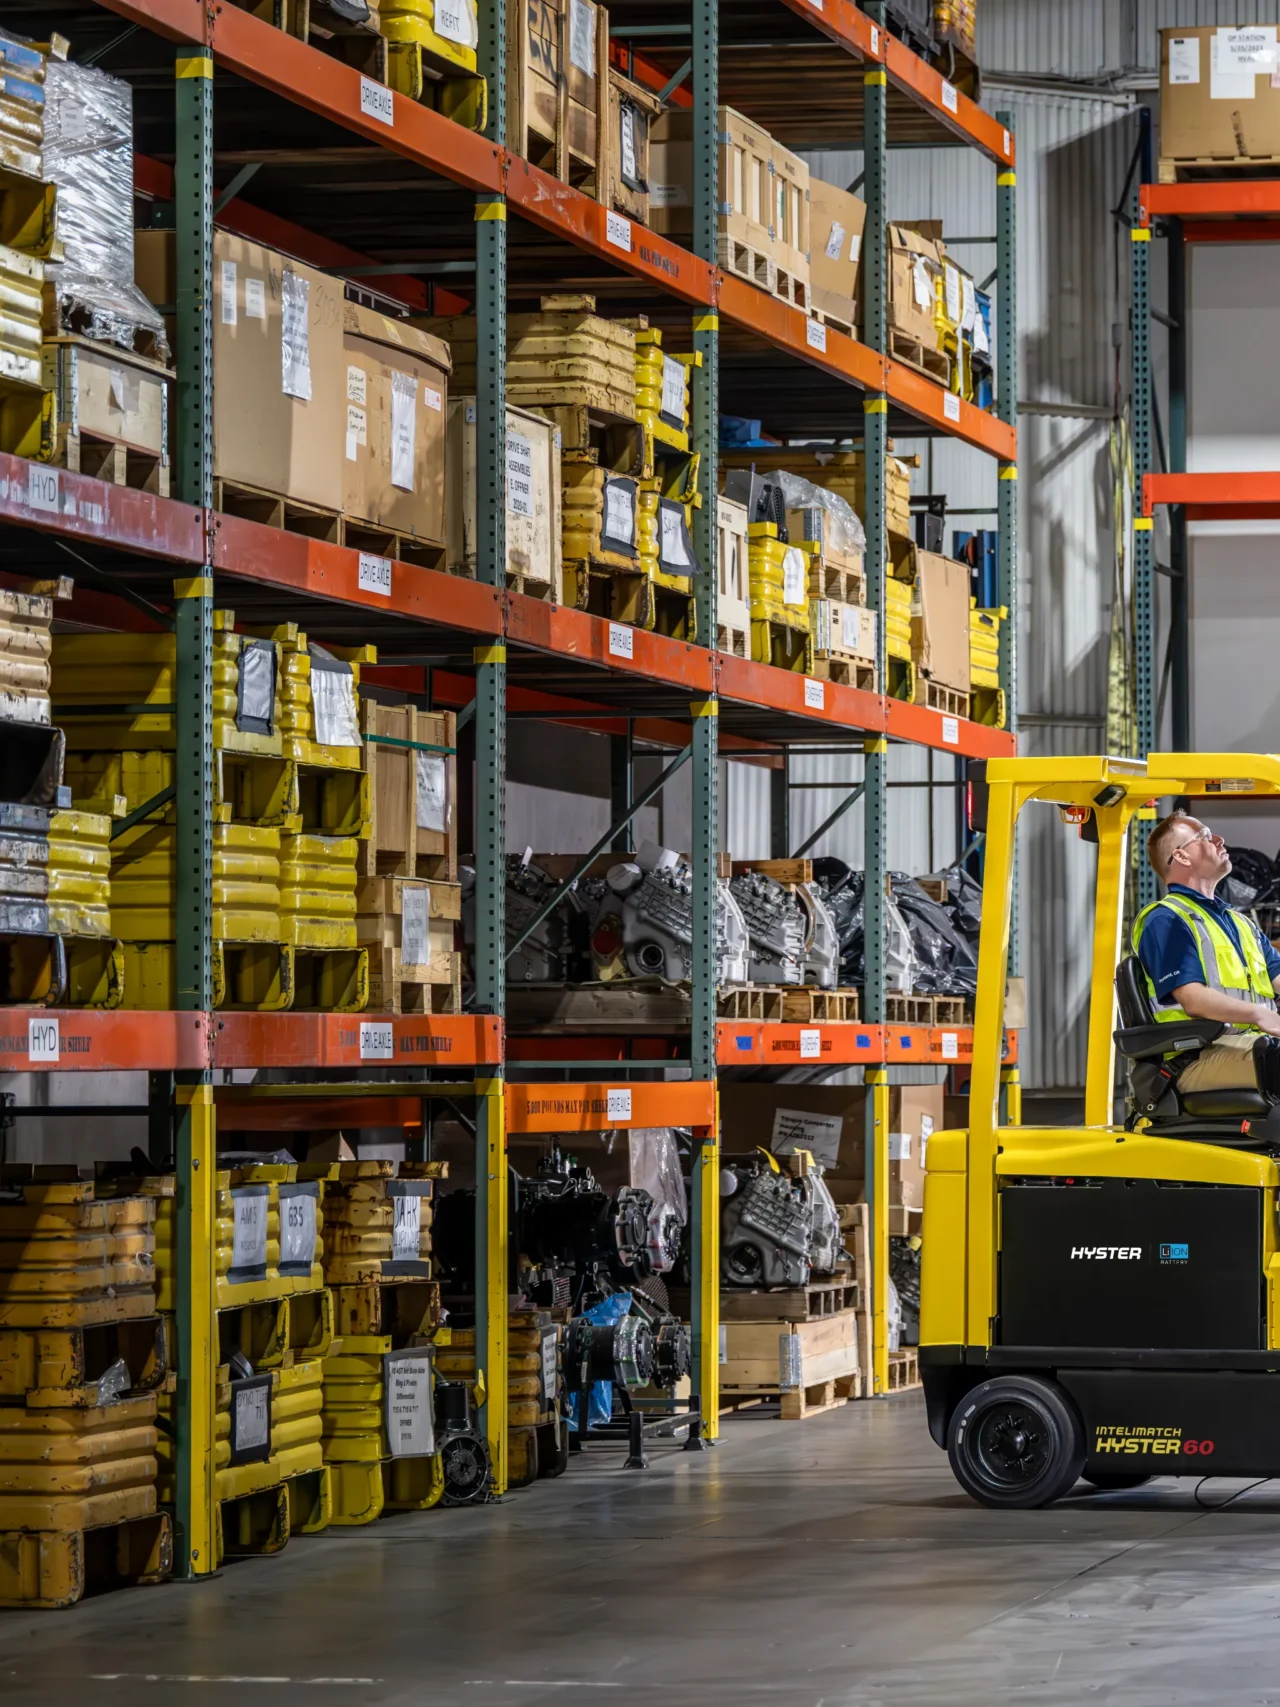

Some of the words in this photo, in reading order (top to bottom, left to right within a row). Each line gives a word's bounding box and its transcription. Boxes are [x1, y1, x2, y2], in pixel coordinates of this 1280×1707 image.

[441, 9, 460, 33] REFIT
[362, 85, 378, 109] DRIVE
[378, 93, 392, 116] AXLE
[508, 440, 520, 455] DRIVE
[32, 473, 57, 503] HYD
[361, 562, 376, 582] DRIVE
[377, 567, 390, 587] AXLE
[32, 1026, 57, 1051] HYD
[362, 1032, 377, 1049] DRIVE
[378, 1032, 392, 1049] AXLE
[541, 1100, 564, 1114] POUNDS
[565, 1100, 577, 1113] MAX
[288, 1206, 304, 1228] 635
[1070, 1246, 1142, 1260] HYSTER
[1162, 1247, 1170, 1256] Li
[1171, 1247, 1188, 1256] ION
[1096, 1426, 1182, 1437] INTELIMATCH
[1096, 1438, 1181, 1455] HYSTER
[1183, 1439, 1214, 1455] 60
